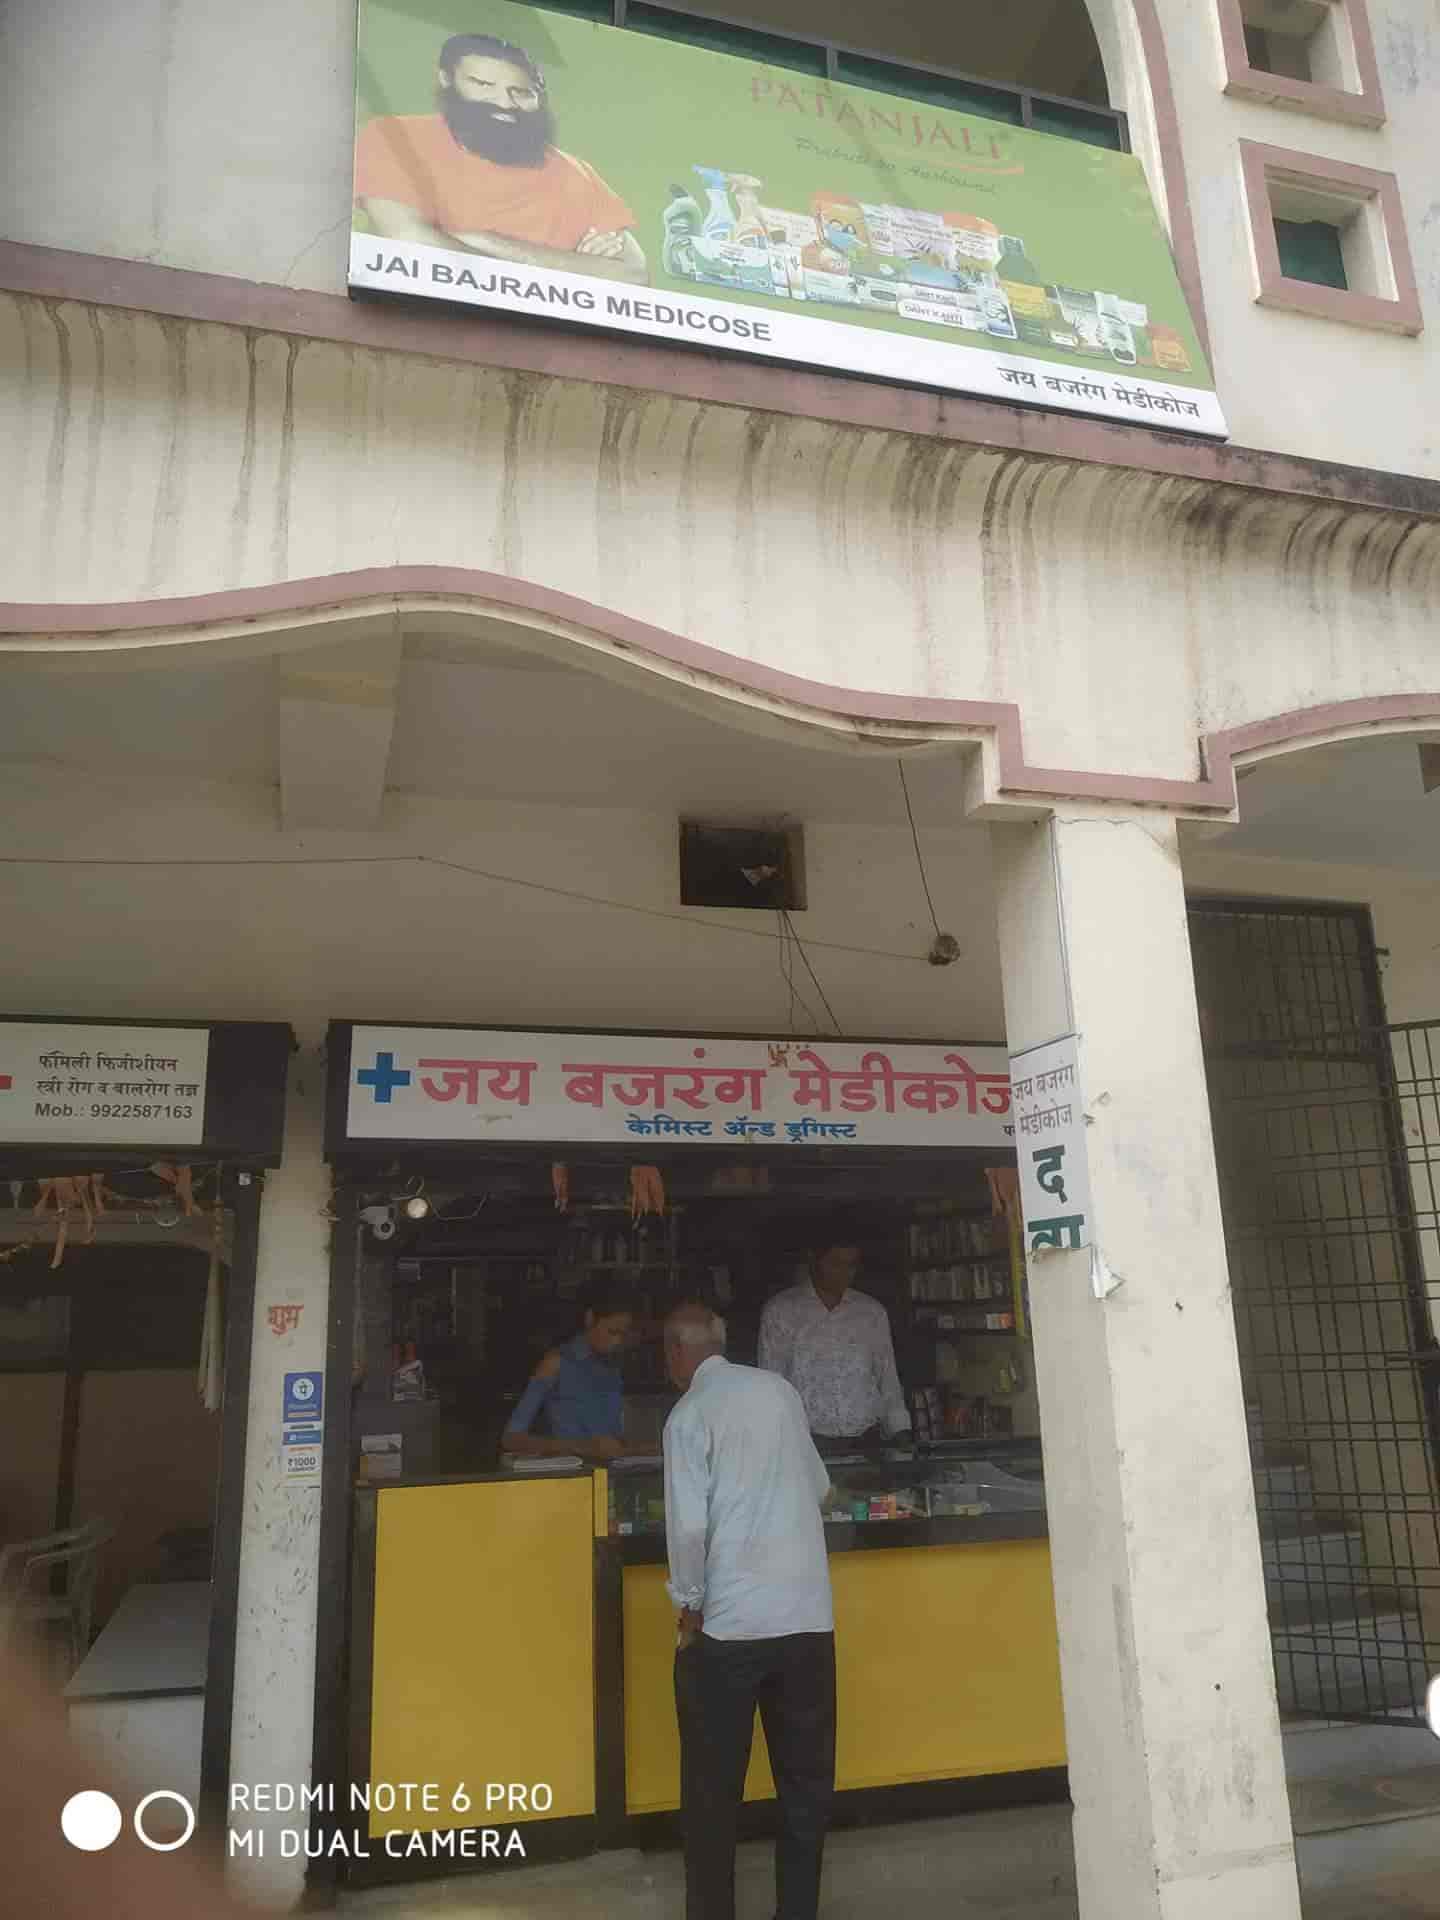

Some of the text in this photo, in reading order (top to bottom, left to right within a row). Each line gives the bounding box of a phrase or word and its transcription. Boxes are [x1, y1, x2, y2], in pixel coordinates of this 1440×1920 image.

[366, 252, 420, 280] JAI
[431, 262, 596, 311] BAJRANG
[605, 295, 774, 343] MEDICOSE
[999, 365, 1201, 418] जय बजरंग मेडीकोज
[67, 1077, 93, 1095] रोग
[98, 1081, 109, 1095] व
[417, 1057, 538, 1108] जय
[561, 1047, 770, 1113] बजरंग
[1012, 1059, 1075, 1103] जय बजरंग
[91, 1104, 193, 1119] 9922587163
[624, 1113, 713, 1137] केमिस्ट
[783, 1117, 857, 1142] ड्रगिस्ट
